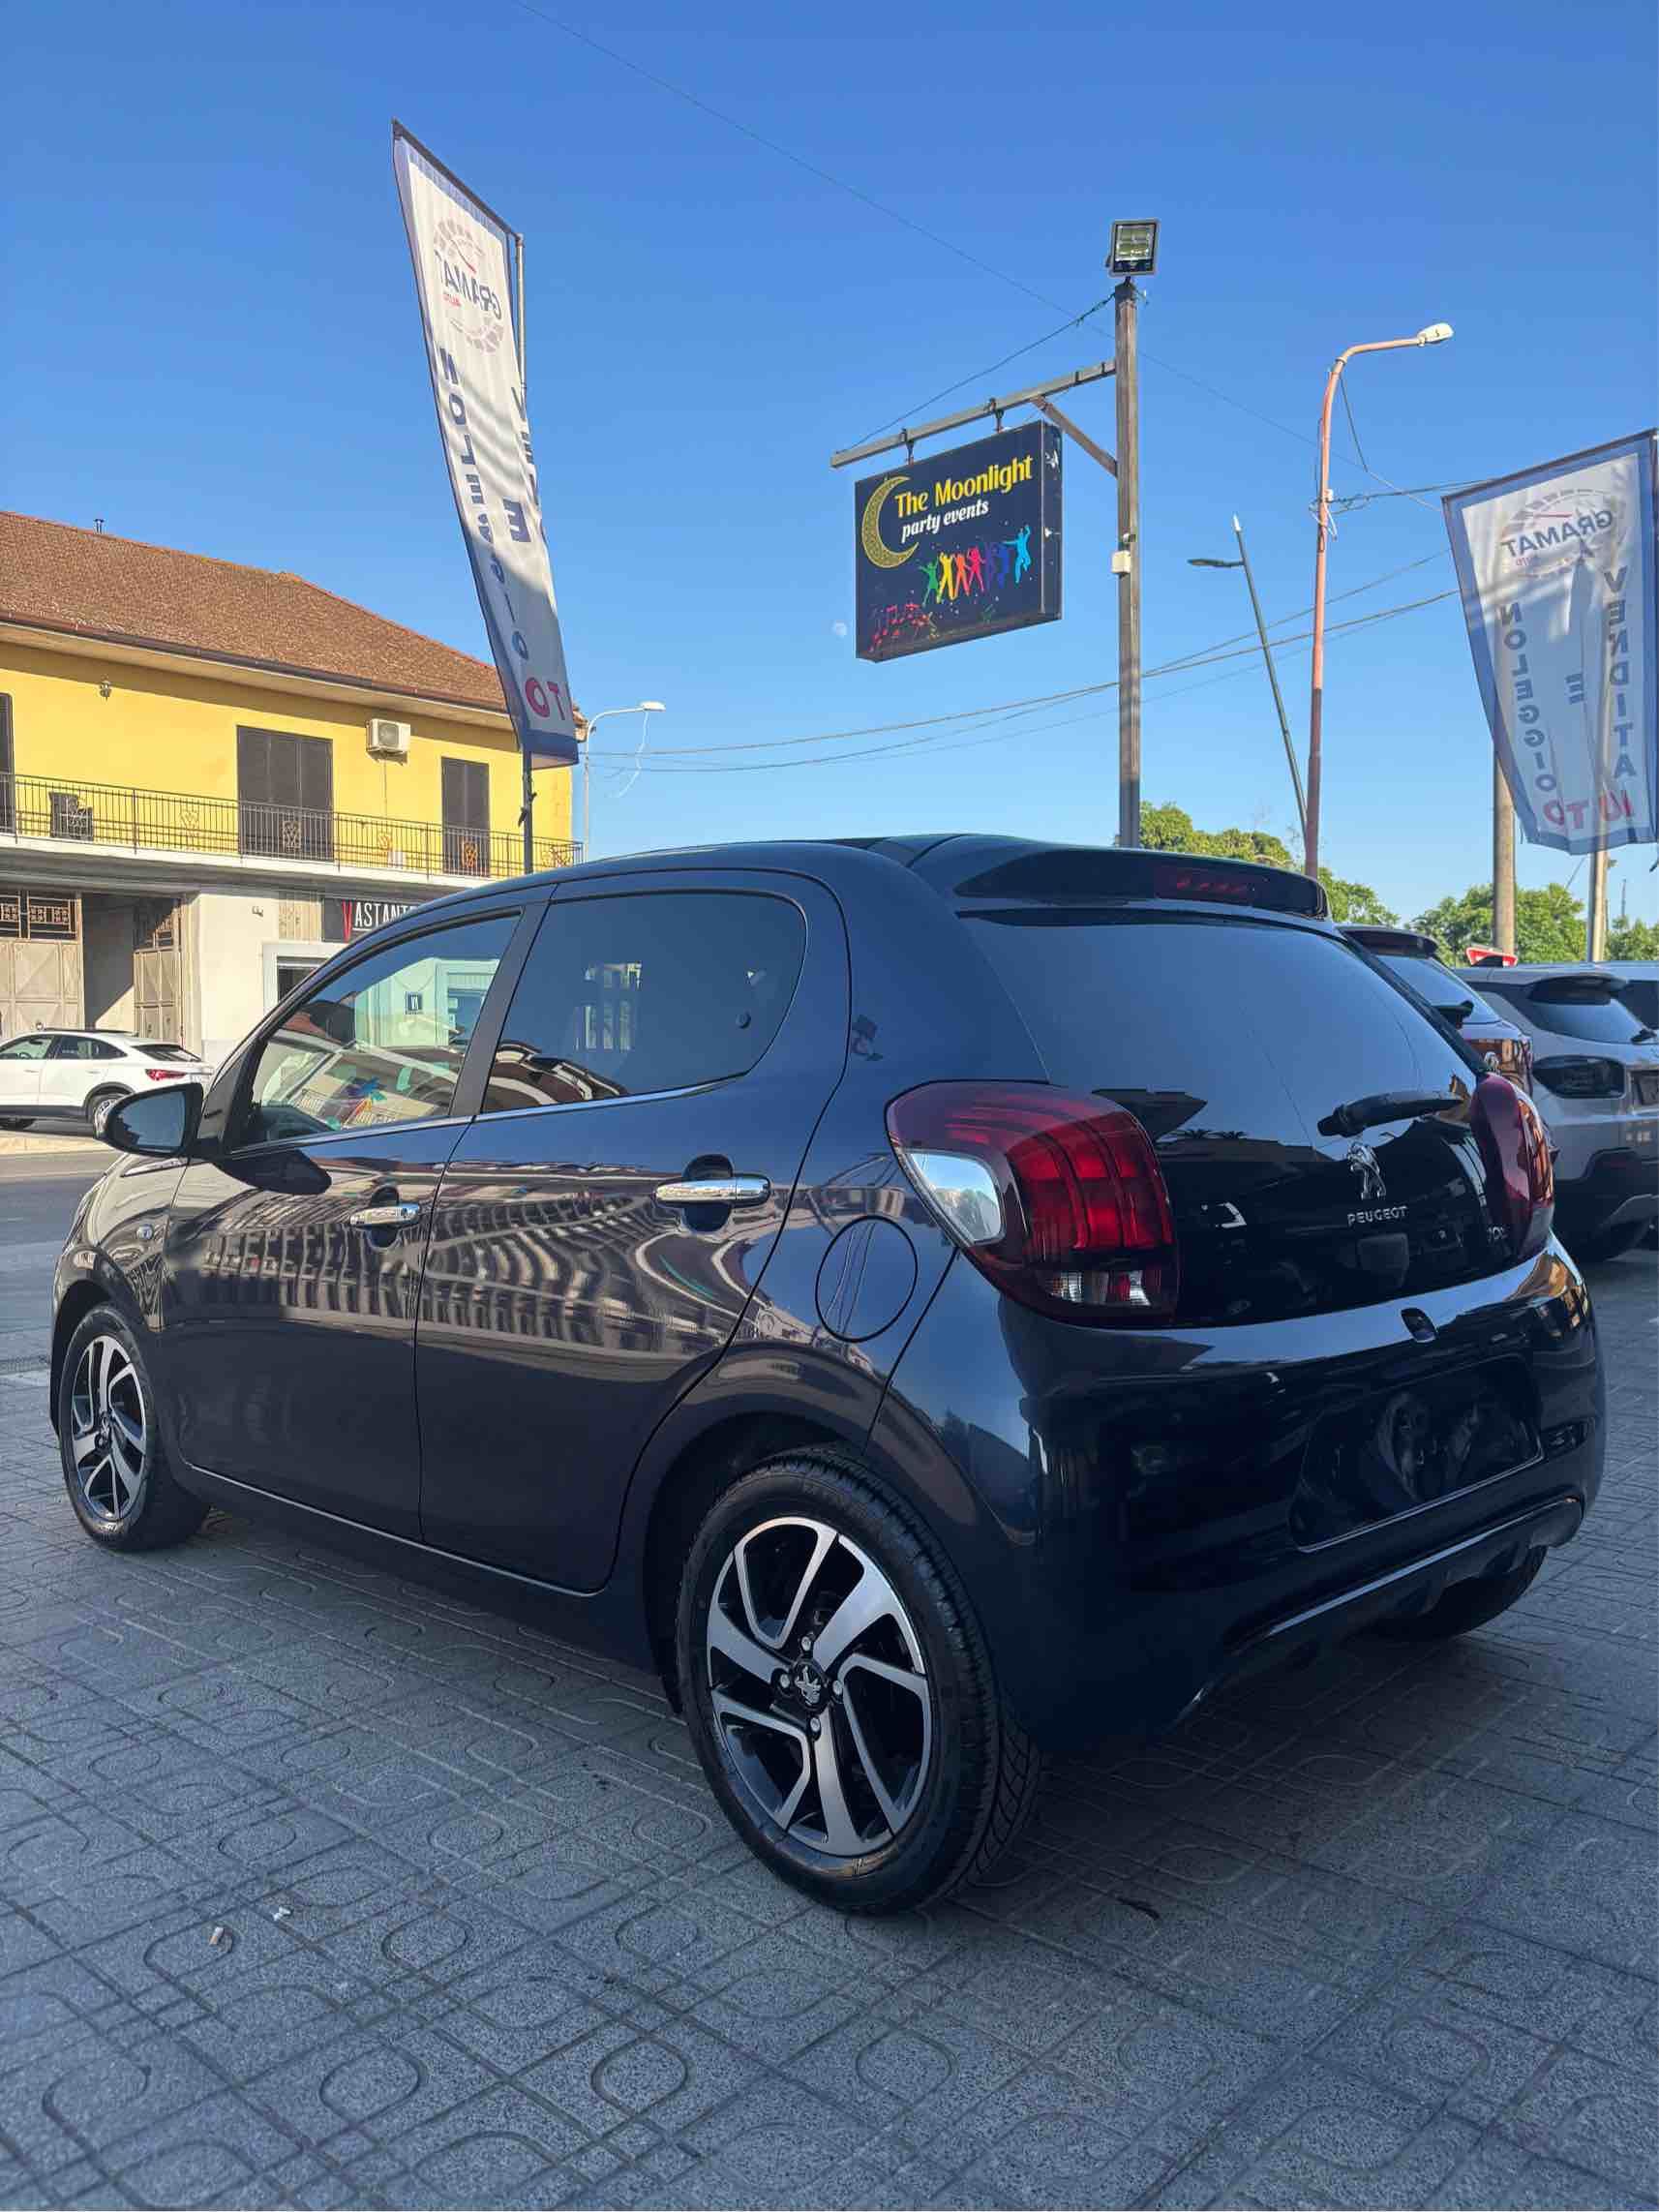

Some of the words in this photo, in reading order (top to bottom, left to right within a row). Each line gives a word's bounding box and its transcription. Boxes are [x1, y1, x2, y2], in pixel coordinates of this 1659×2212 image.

[894, 491, 928, 519] The
[934, 454, 1034, 507] Moonlight
[900, 512, 941, 543] party
[943, 499, 989, 527] events
[342, 898, 414, 944] VASTANT
[1346, 1203, 1409, 1227] PEUGEOT
